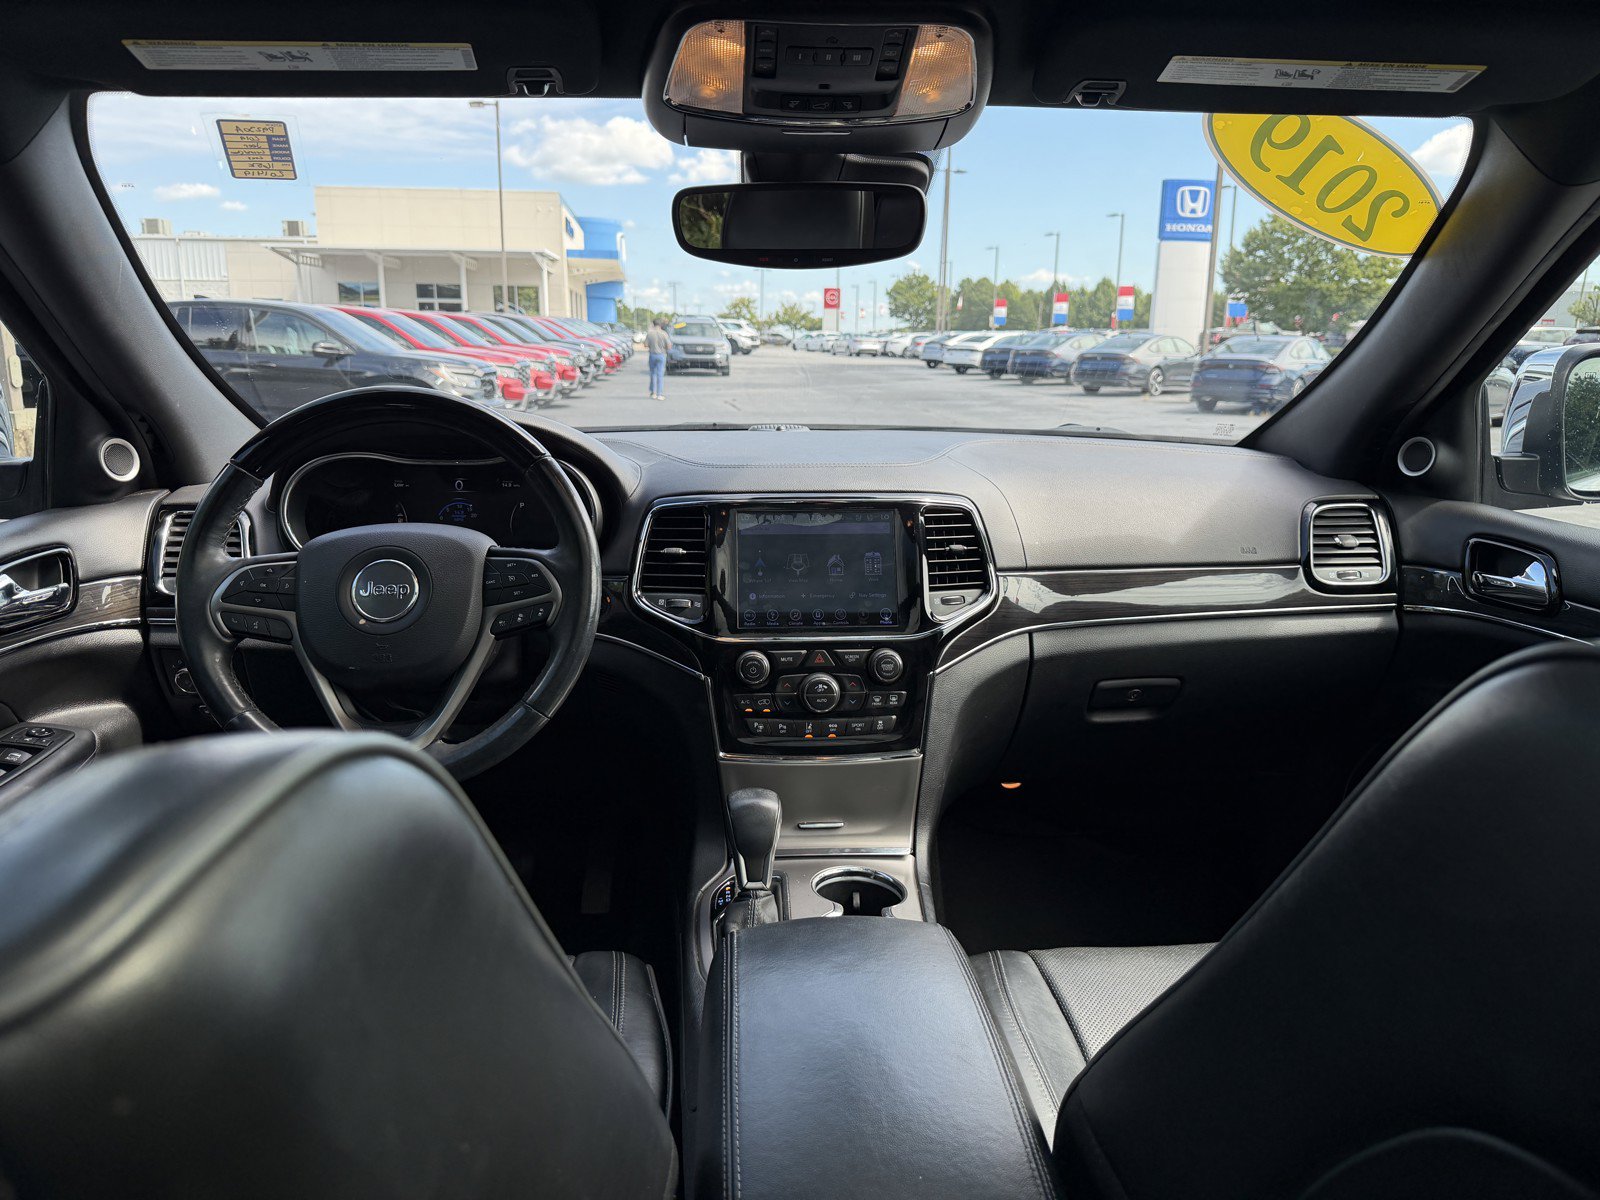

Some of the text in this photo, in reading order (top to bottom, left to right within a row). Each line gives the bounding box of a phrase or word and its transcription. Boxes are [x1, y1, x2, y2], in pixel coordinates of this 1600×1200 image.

[1164, 222, 1214, 233] HONDA
[454, 480, 464, 491] 0
[359, 580, 410, 600] Jeep
